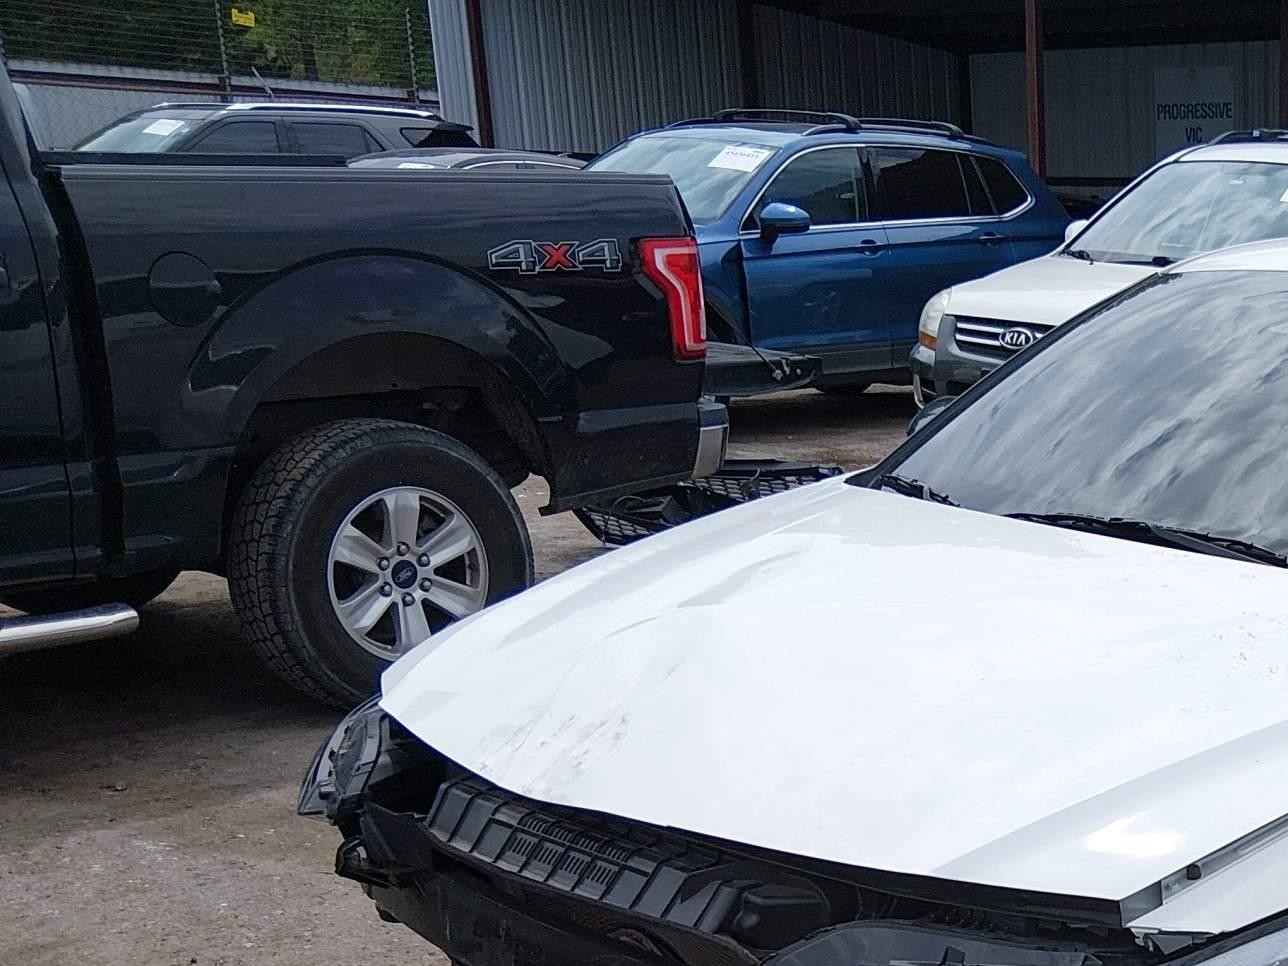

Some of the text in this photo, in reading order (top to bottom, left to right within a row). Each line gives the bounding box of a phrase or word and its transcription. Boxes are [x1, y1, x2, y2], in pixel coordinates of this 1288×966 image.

[1156, 102, 1233, 121] PROGRESSIVE
[1185, 126, 1203, 144] VIC
[1004, 331, 1026, 346] KIA
